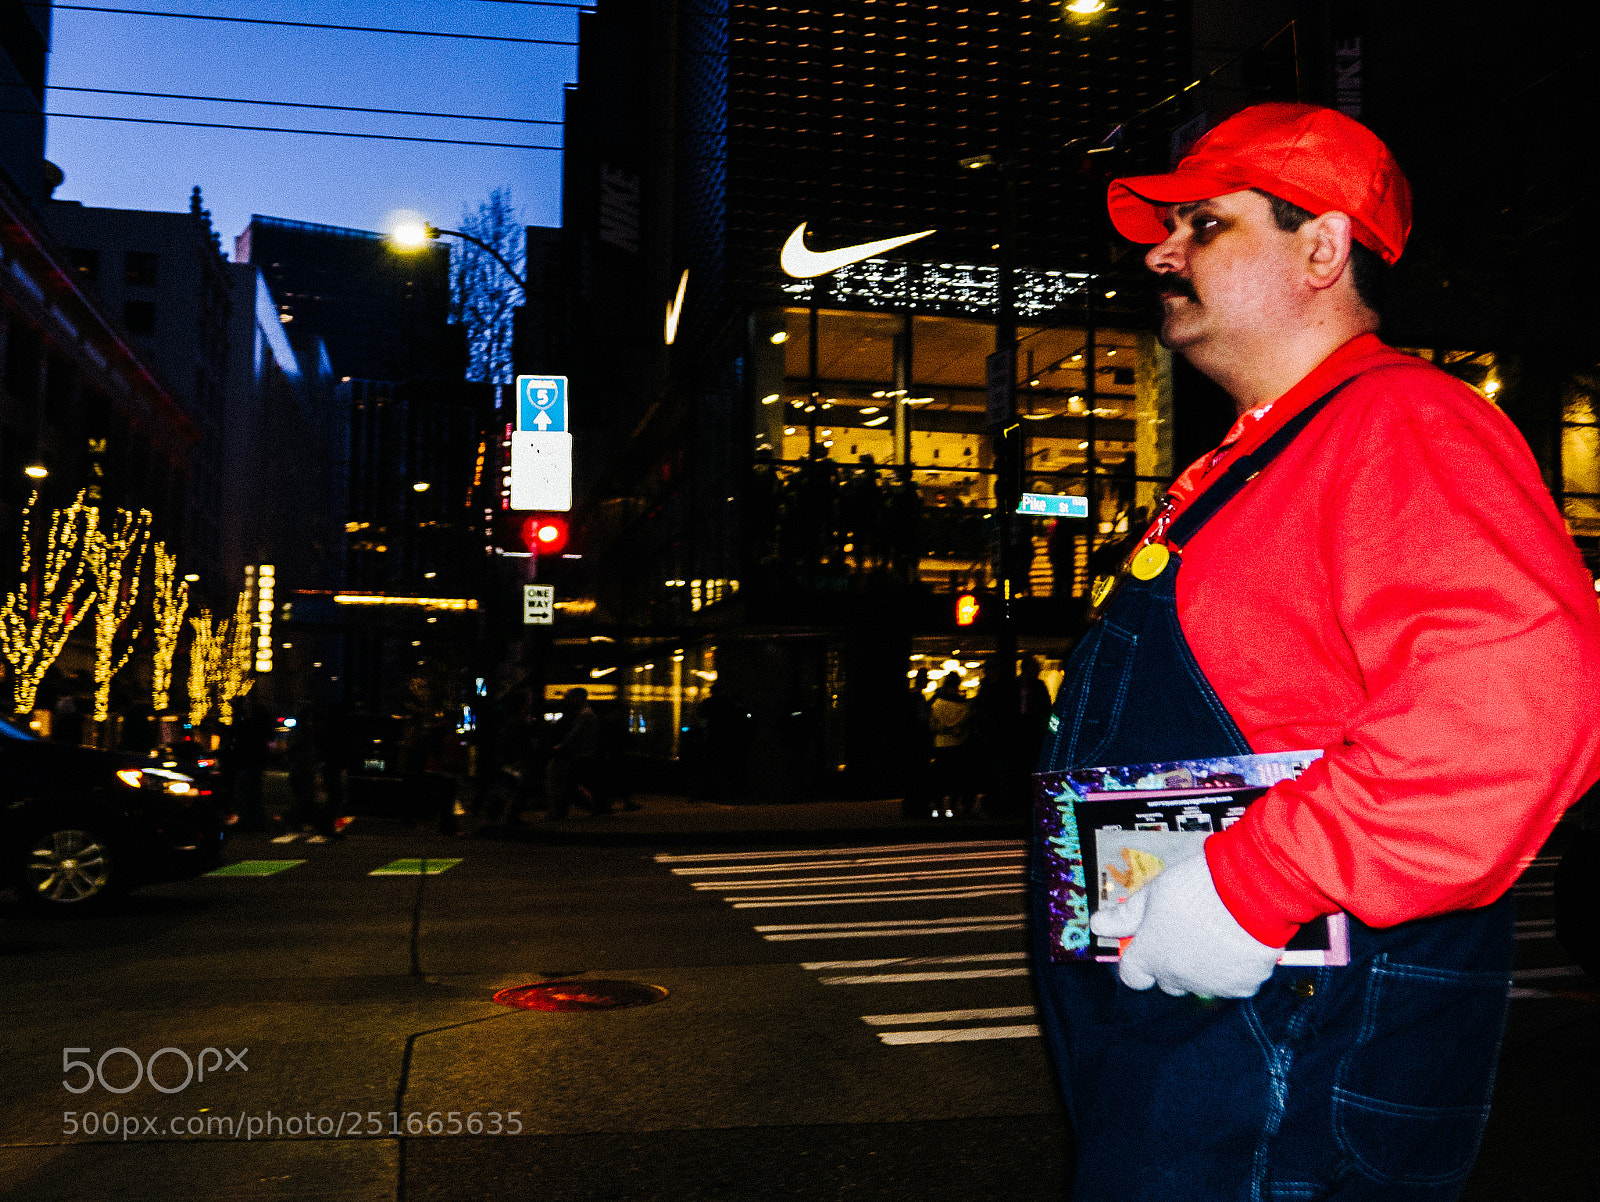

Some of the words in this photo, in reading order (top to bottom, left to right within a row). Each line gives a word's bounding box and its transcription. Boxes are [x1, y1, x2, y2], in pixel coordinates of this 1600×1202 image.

[599, 161, 640, 254] NIKE
[537, 389, 549, 405] 5
[1022, 495, 1047, 512] Pike
[528, 589, 550, 598] ONE
[528, 600, 549, 608] WAY
